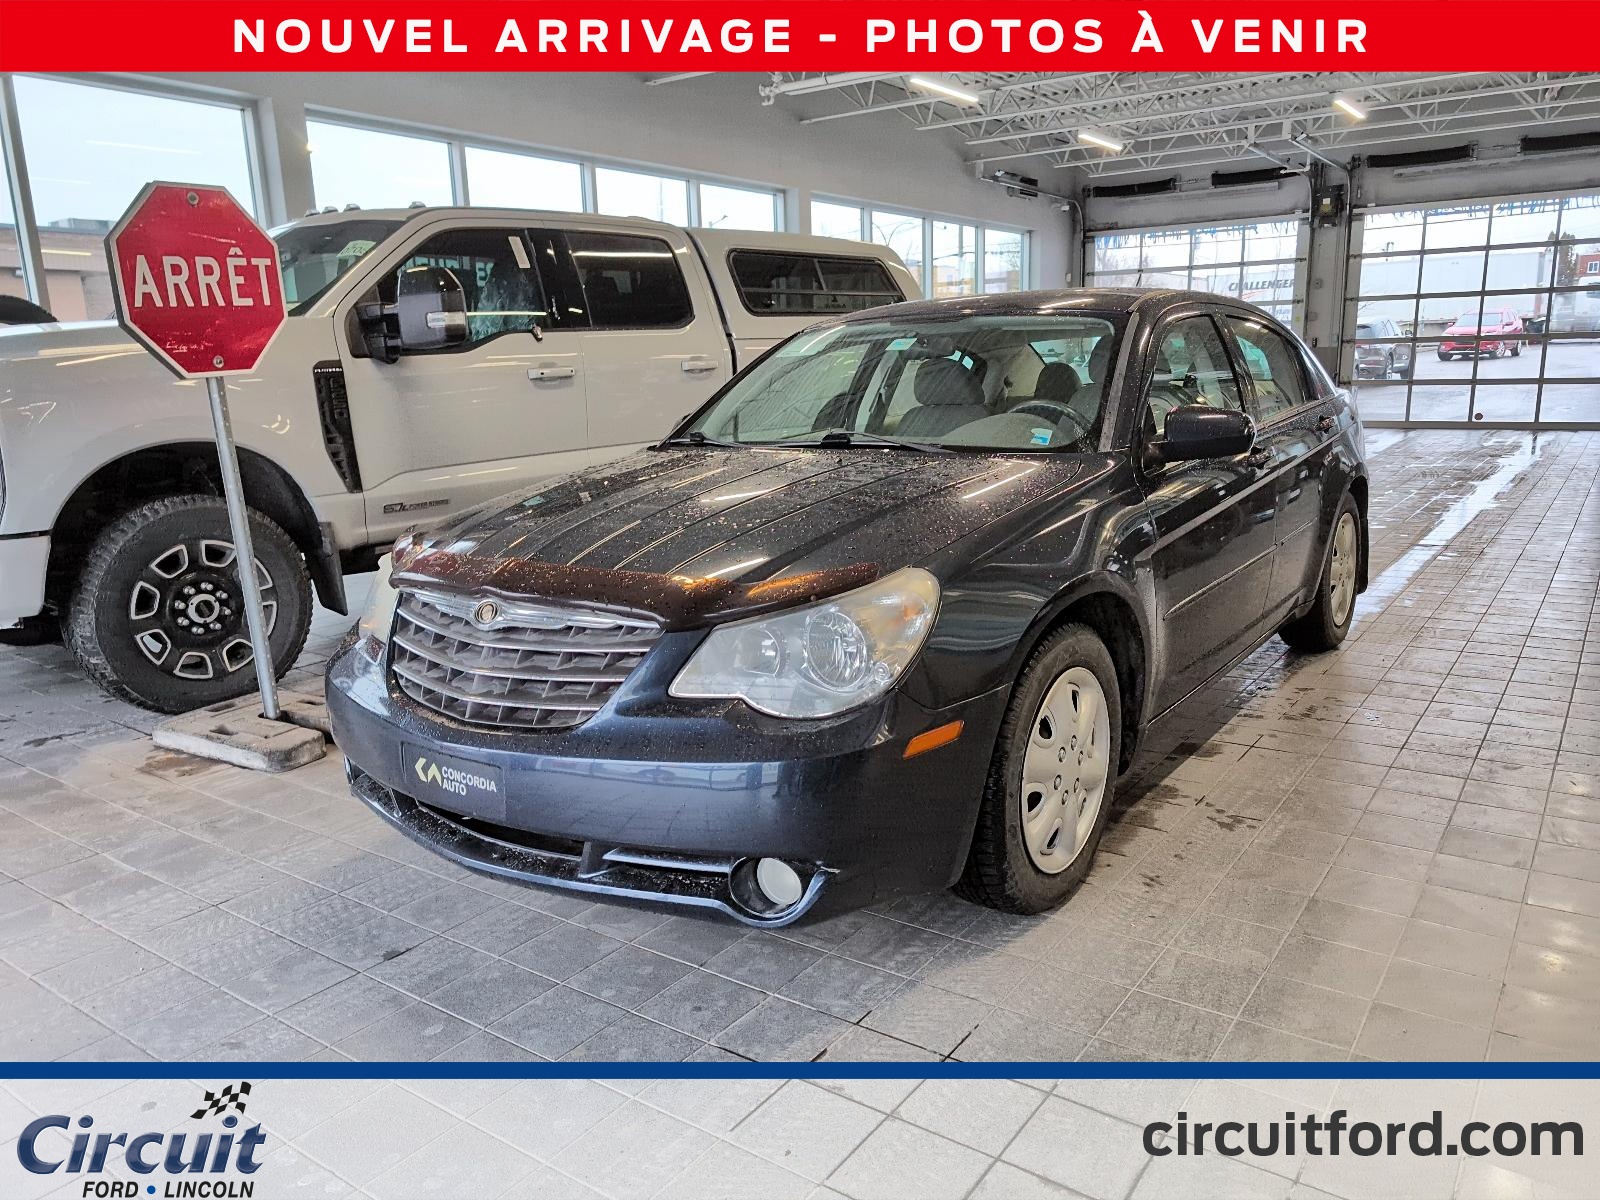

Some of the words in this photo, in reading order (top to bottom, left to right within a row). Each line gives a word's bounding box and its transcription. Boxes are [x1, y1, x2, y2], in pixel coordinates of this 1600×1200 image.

[134, 247, 271, 308] ARRÊT
[441, 766, 497, 793] CONCORDIA
[442, 780, 467, 796] AUTO
